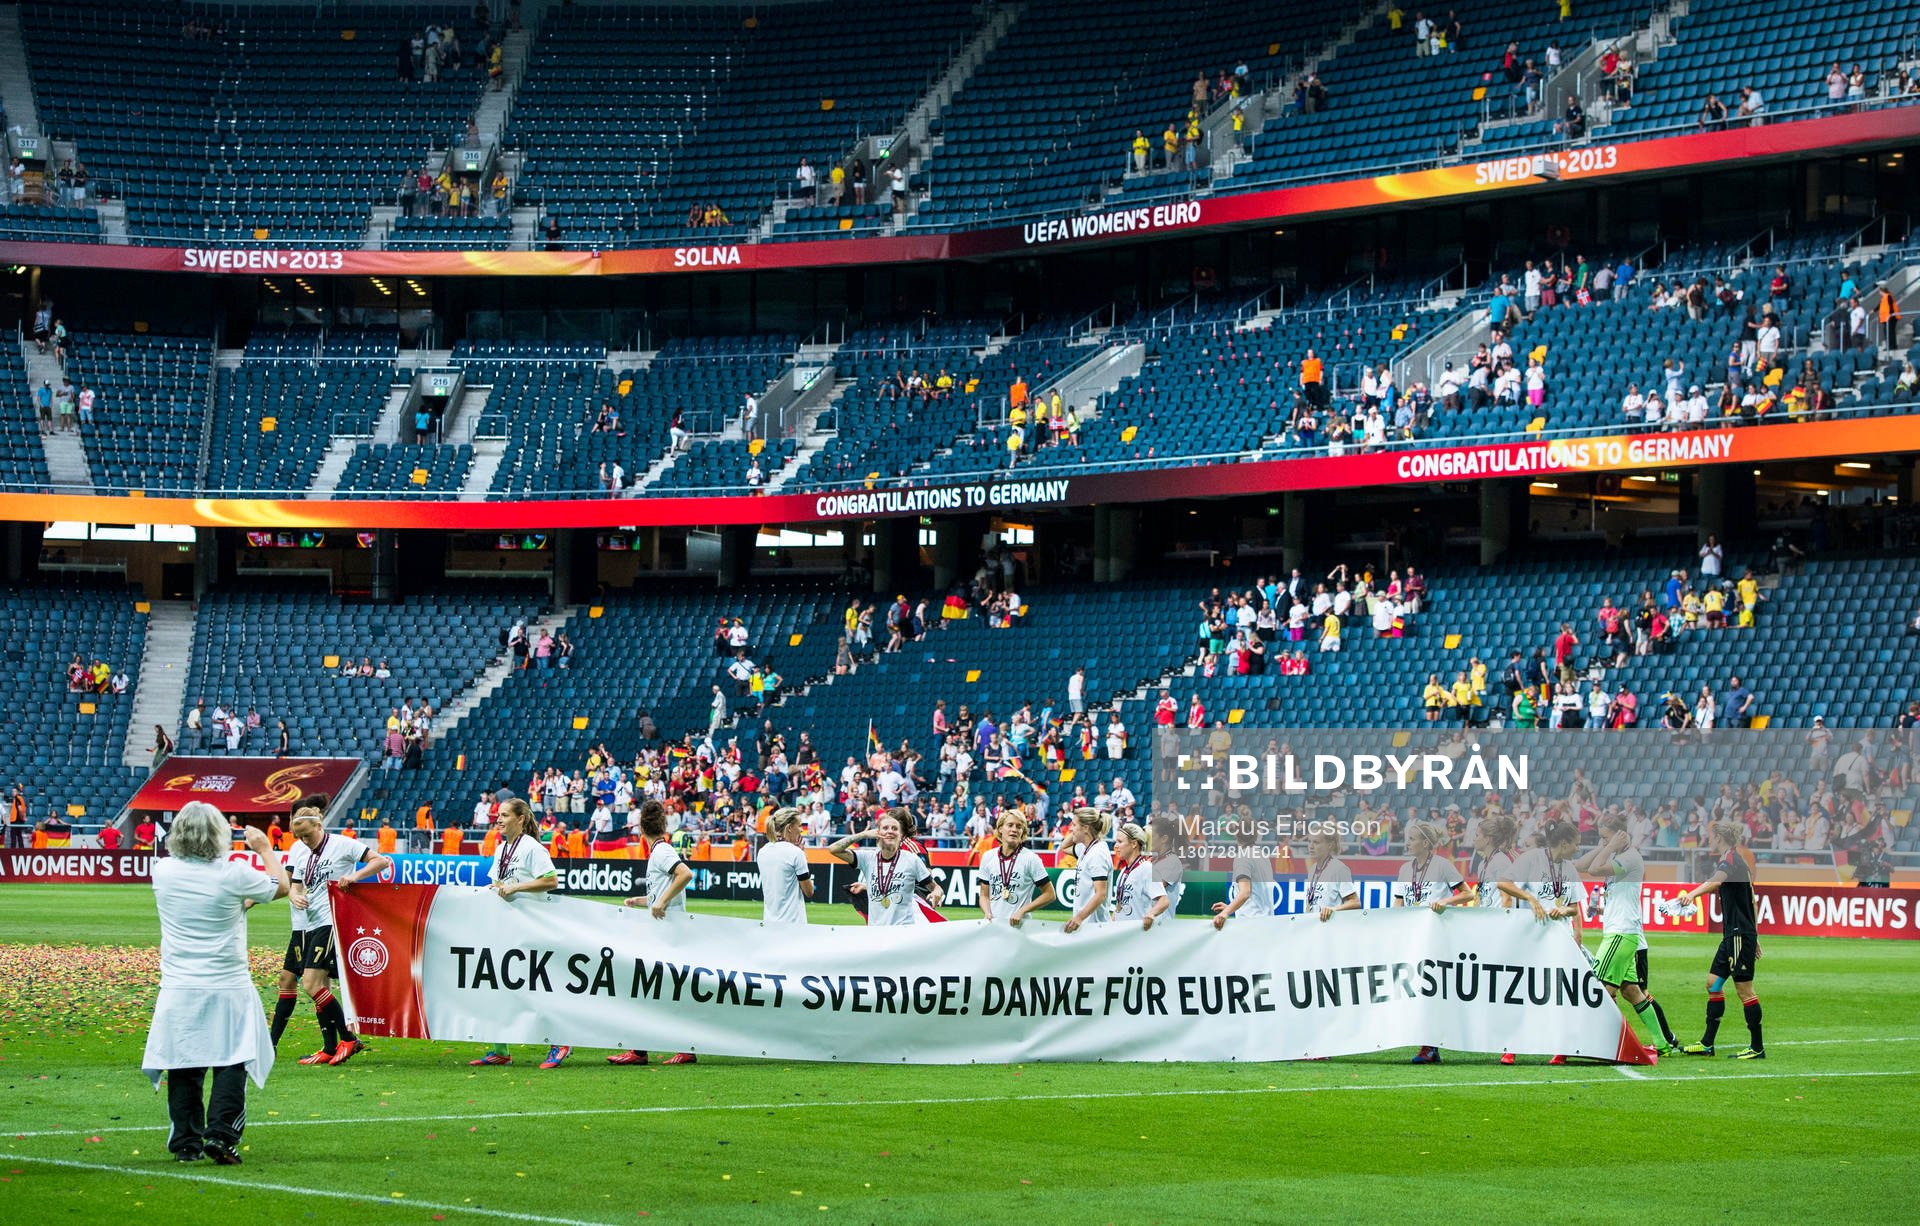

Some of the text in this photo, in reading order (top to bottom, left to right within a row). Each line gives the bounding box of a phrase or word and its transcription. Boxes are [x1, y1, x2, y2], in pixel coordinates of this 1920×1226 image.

[20, 139, 36, 147] 317
[464, 151, 480, 160] 316
[1024, 201, 1201, 244] UEFA WOMEN'S EURO
[674, 246, 741, 267] SOLNA
[433, 377, 448, 386] 216
[1397, 433, 1735, 478] CONGRATULATIONS TO GERMANY
[816, 480, 1069, 516] CONGRATULATIONS TO GERMANY
[11, 855, 114, 877] WOMEN'S
[119, 855, 161, 877] EUR
[401, 860, 480, 886] RESPECT
[567, 863, 632, 891] adidas
[727, 872, 762, 889] POW
[1782, 896, 1907, 929] WOMEN'S
[314, 946, 324, 963] 7
[450, 947, 1602, 1017] TACK SÅ MYCKET SVERIGE! DANKE FÜR EURE UNTERSTÜTZUNG
